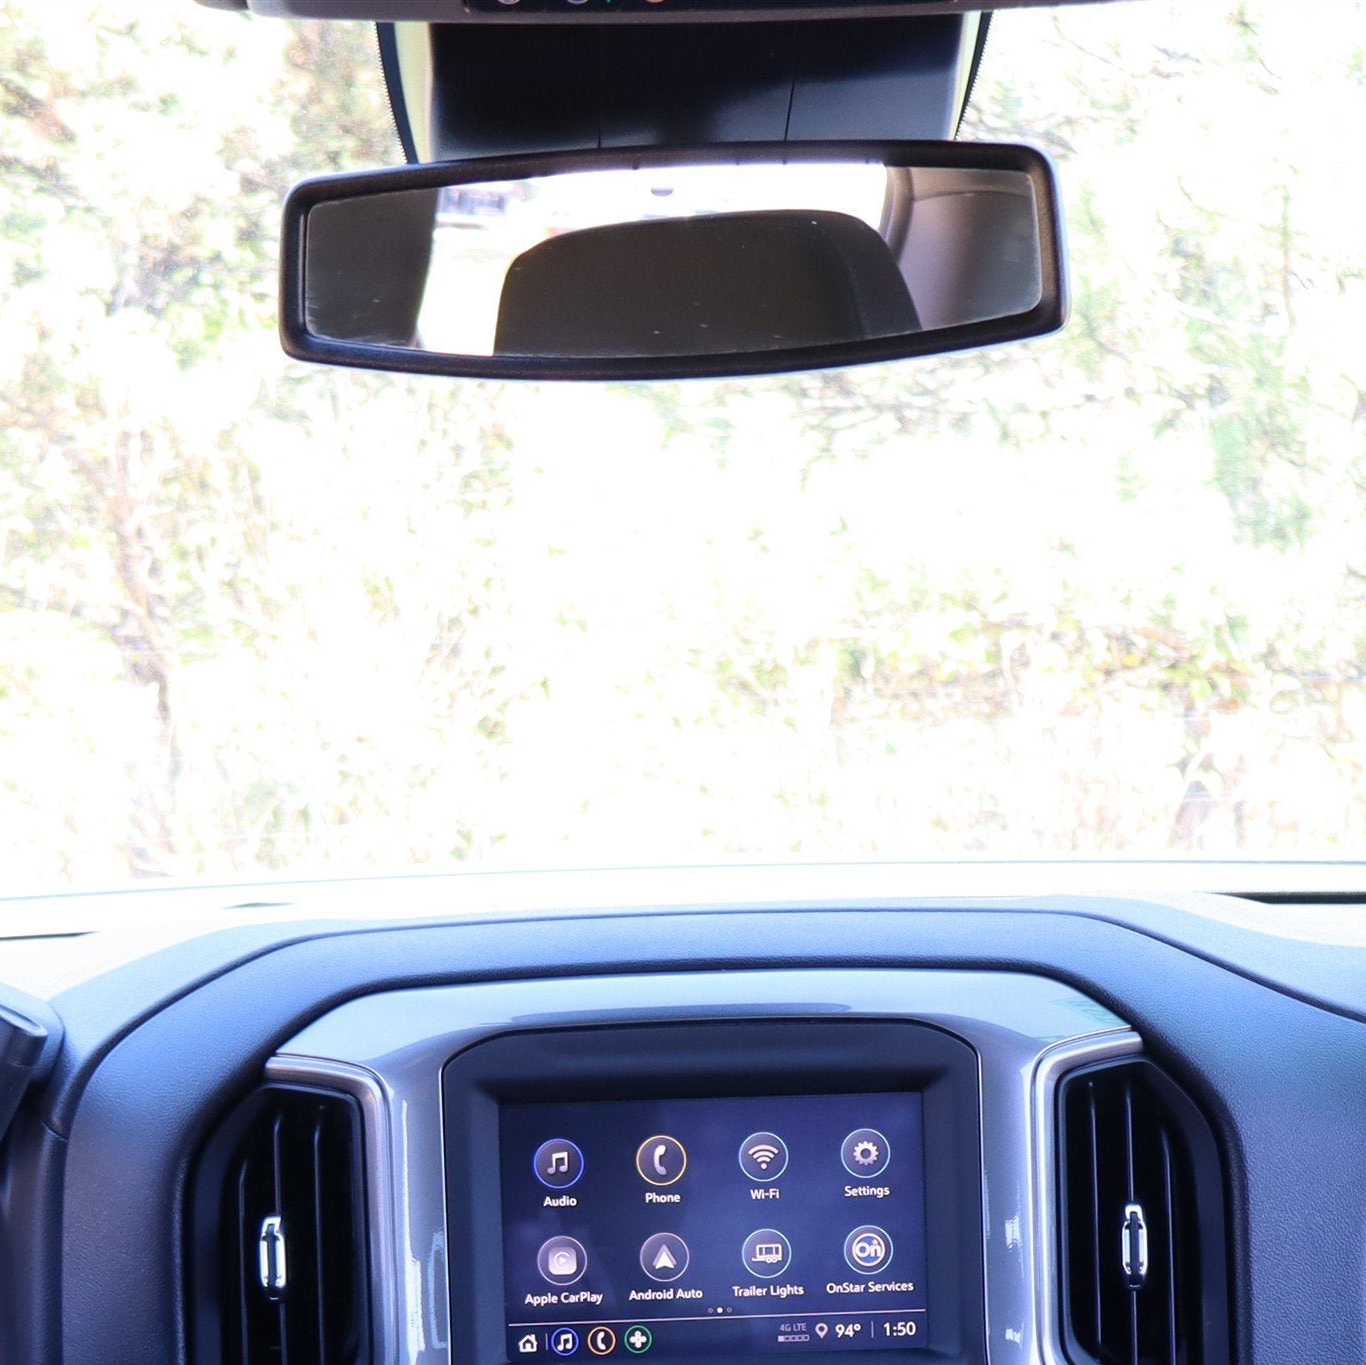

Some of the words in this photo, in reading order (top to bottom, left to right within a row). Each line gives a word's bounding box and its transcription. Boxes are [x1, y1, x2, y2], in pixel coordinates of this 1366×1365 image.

[645, 1192, 681, 1204] Phone
[750, 1188, 780, 1200] Wi-Fi
[844, 1185, 891, 1199] Settings
[543, 1195, 577, 1207] Audio
[628, 1288, 674, 1301] Android
[676, 1287, 703, 1299] Auto
[732, 1286, 767, 1297] Trailer
[770, 1284, 805, 1298] Lights
[826, 1282, 865, 1294] OnStar
[867, 1281, 914, 1293] Services
[524, 1293, 559, 1307] Apple
[560, 1291, 603, 1305] CarPlay
[779, 1323, 791, 1332] 4G
[793, 1322, 807, 1331] LTE
[883, 1321, 917, 1337] 1:50
